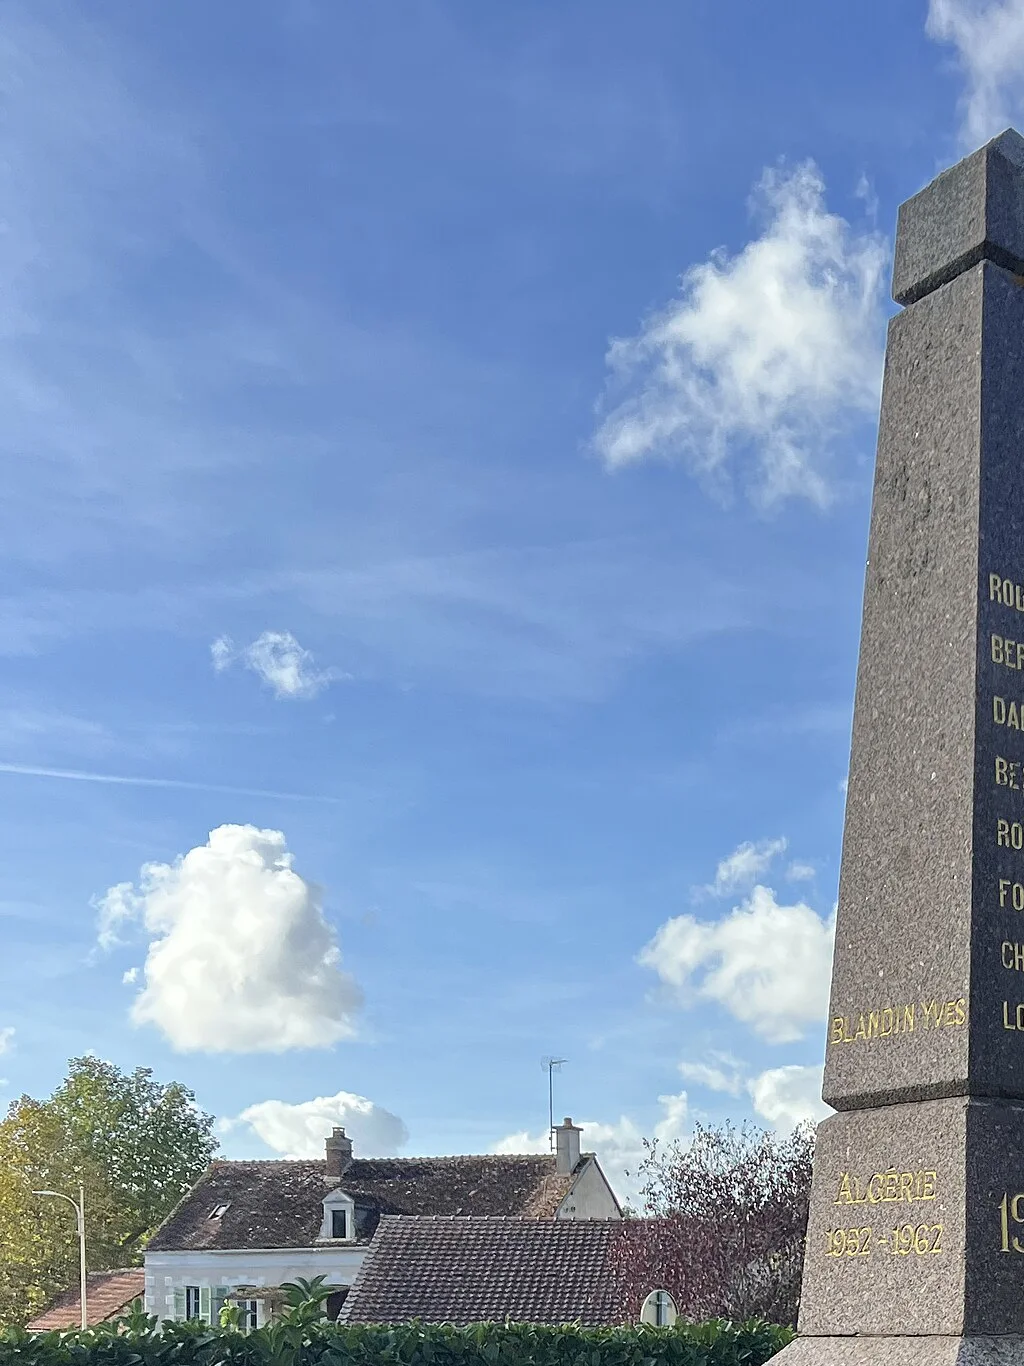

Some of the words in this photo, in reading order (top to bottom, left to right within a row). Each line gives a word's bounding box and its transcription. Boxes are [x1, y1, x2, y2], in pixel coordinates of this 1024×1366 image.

[831, 1002, 915, 1046] BLANDIN
[920, 998, 967, 1028] YVES
[834, 1165, 937, 1205] ALGÉRIE
[824, 1227, 872, 1257] 1952
[891, 1223, 945, 1256] 1962
